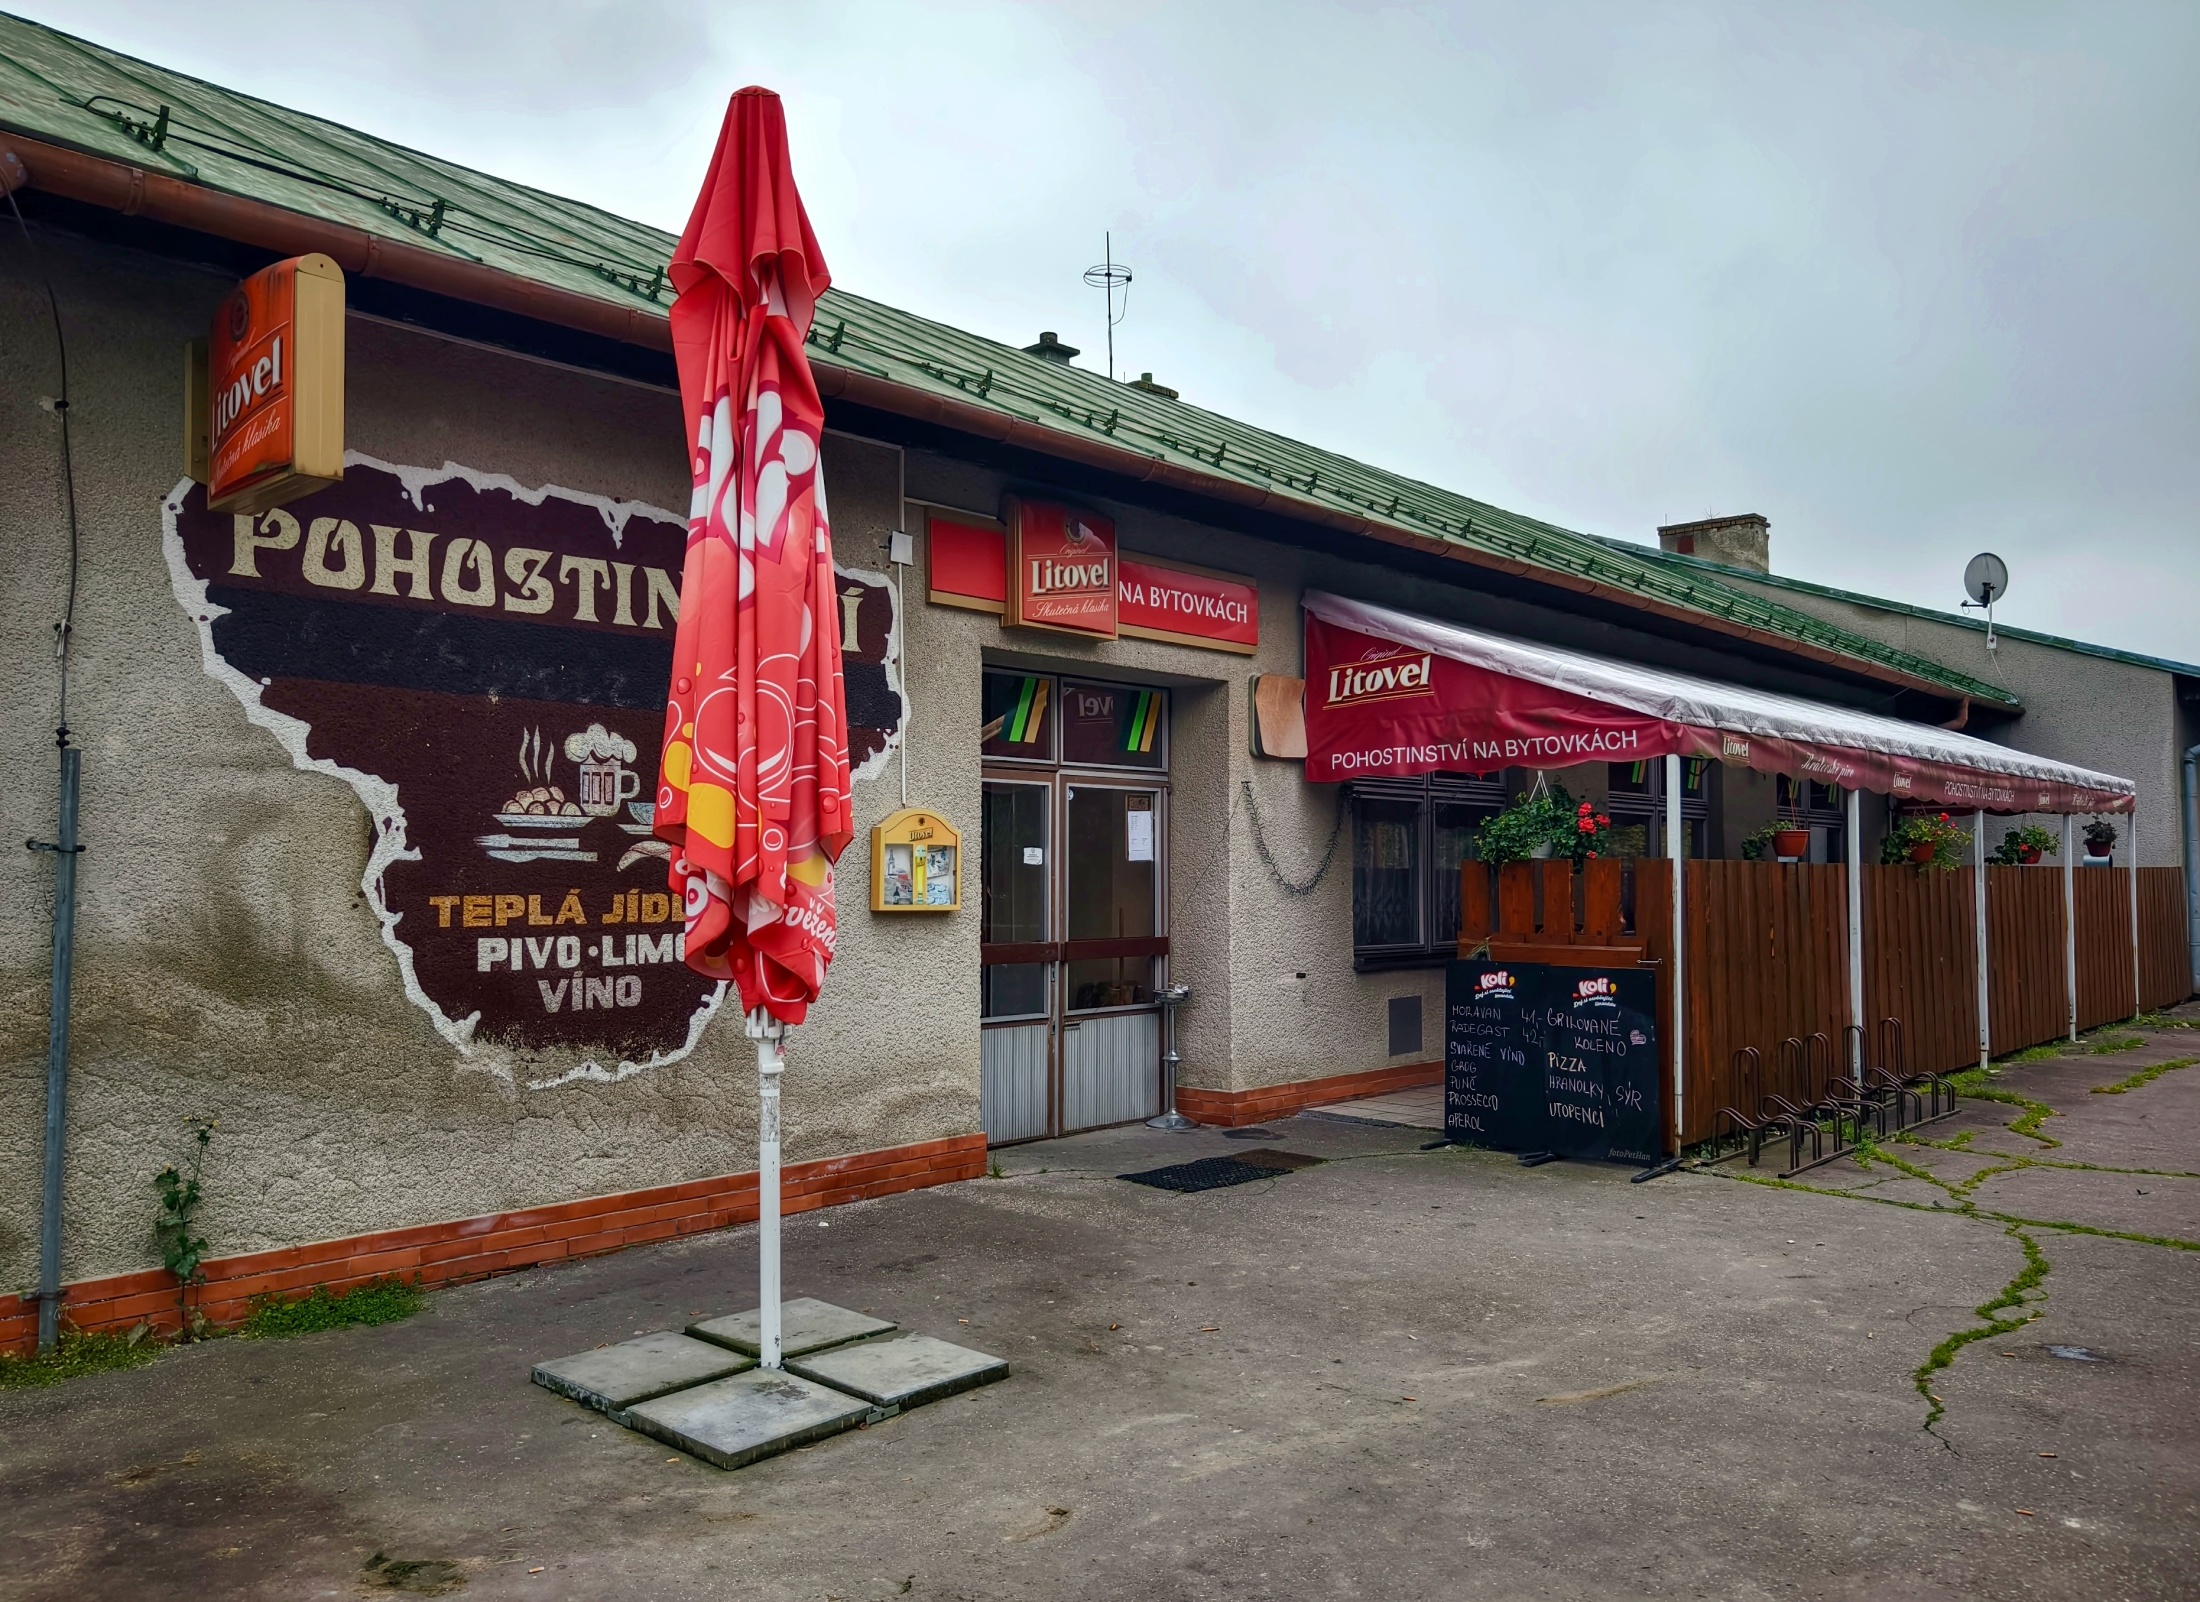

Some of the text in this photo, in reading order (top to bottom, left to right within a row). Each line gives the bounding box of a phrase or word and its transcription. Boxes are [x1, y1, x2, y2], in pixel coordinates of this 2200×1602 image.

[212, 336, 282, 453] Litovel
[242, 408, 281, 455] klasika
[229, 509, 863, 653] POHOSTINÍ
[1031, 557, 1110, 595] Litovel
[1032, 597, 1109, 618] Skutečná klasika
[1119, 580, 1248, 624] NA BYTOVKÁCH
[1327, 654, 1431, 703] Litovel
[1331, 729, 1638, 770] POHOSTINSTVÍ NA BYTOVKÁCH
[1723, 736, 1749, 757] Litovel
[429, 888, 686, 928] TEPLÁ JÍDL
[477, 936, 583, 972] PIVO
[537, 971, 642, 1014] VÍNO
[1481, 971, 1508, 989] Koli
[1579, 978, 1608, 996] Koli
[1449, 1019, 1510, 1037] RADEGAST
[1547, 1007, 1622, 1037] GRILOVANÉ
[1450, 1040, 1525, 1066] SVAŘENÉ VÍNO
[1574, 1036, 1626, 1056] KOLENO
[1451, 1060, 1477, 1073] GROG
[1450, 1075, 1477, 1091] PUNČ
[1616, 1081, 1642, 1111] SÝR
[1448, 1112, 1485, 1132] APEROL
